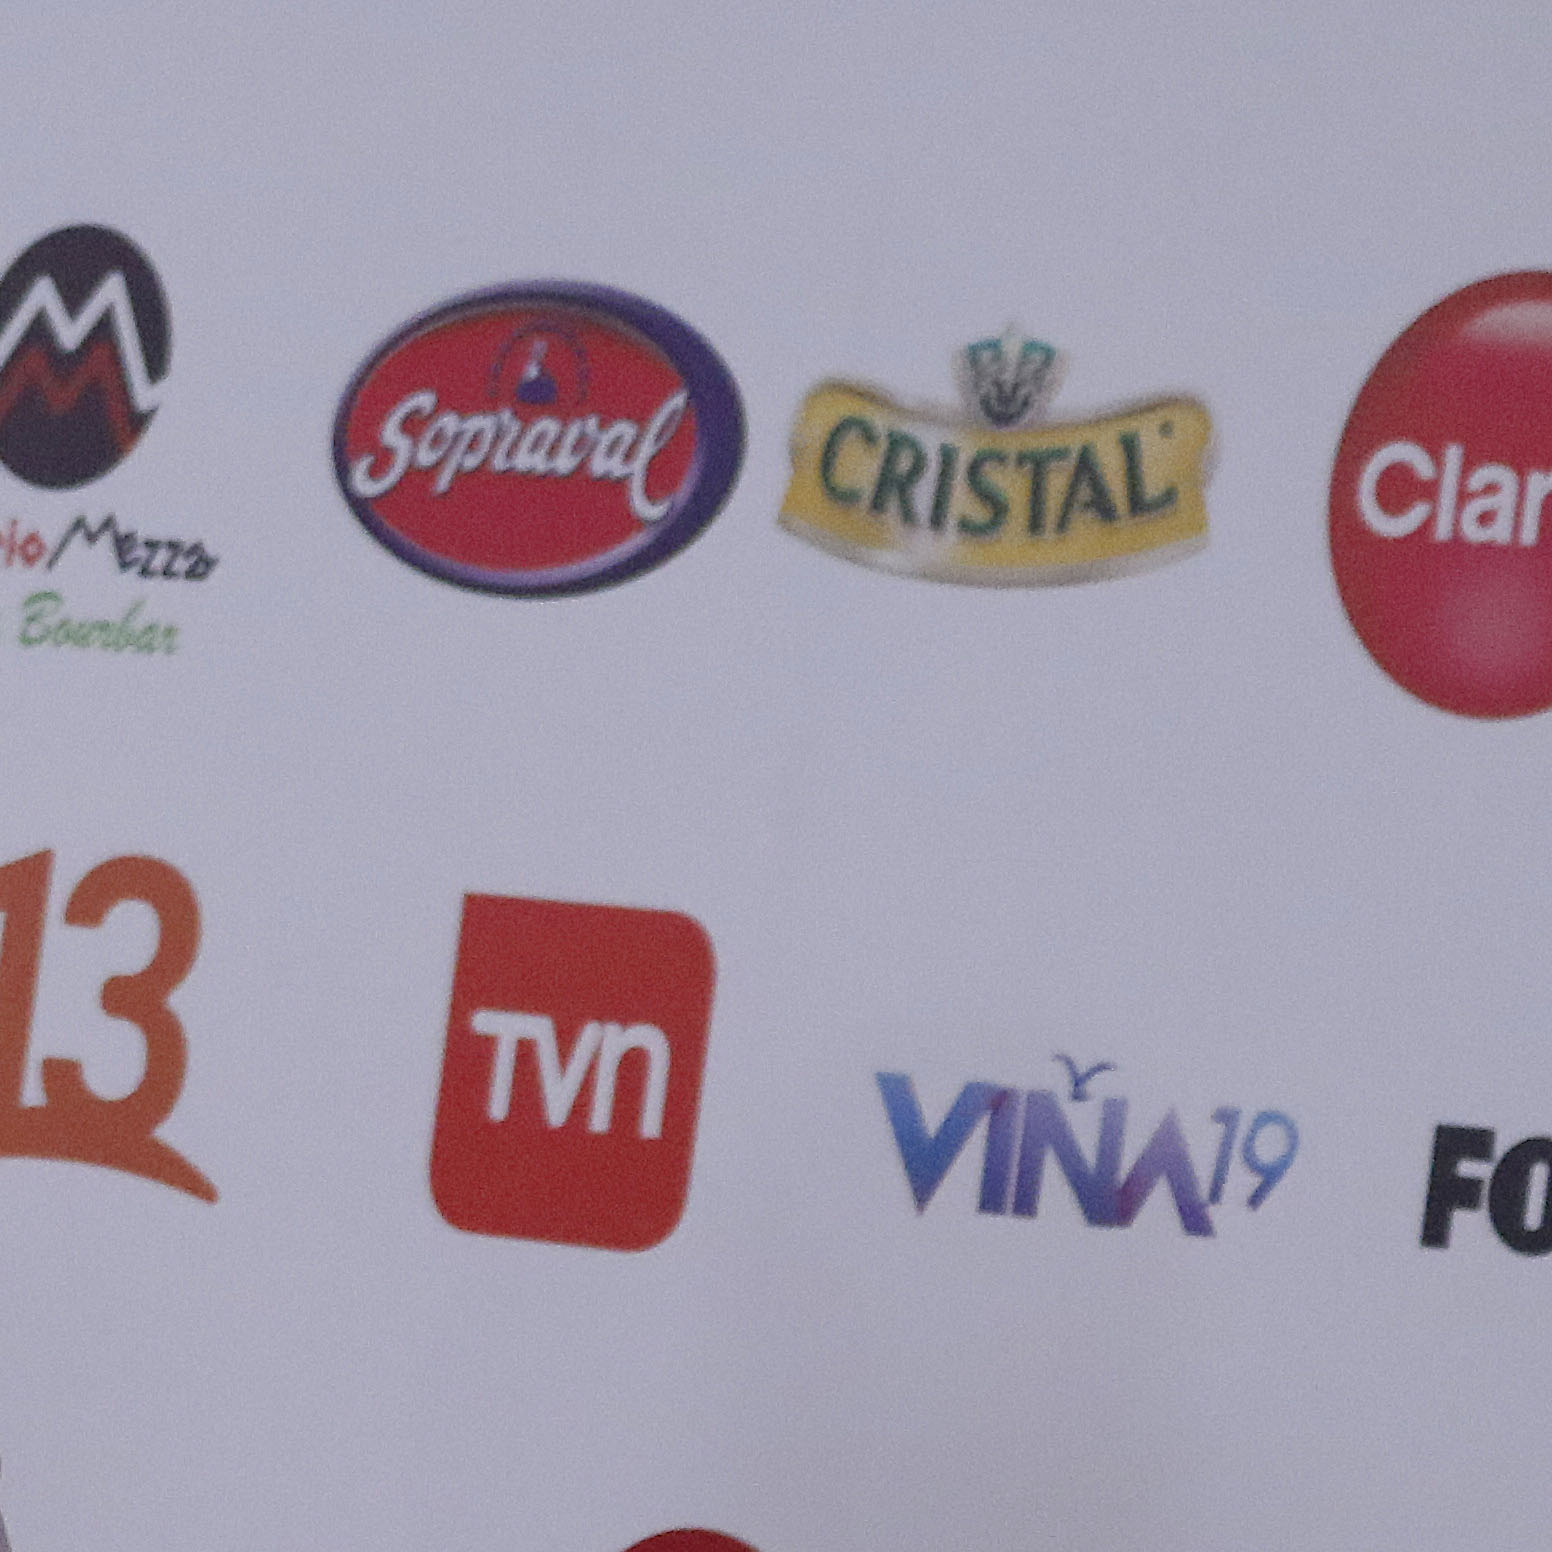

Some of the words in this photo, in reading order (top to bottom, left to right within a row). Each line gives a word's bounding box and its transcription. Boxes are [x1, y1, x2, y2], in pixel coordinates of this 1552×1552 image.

[348, 387, 689, 523] Sopraval
[818, 413, 1179, 539] CRISTAL
[1357, 439, 1552, 547] Clar
[1420, 1122, 1552, 1258] FO
